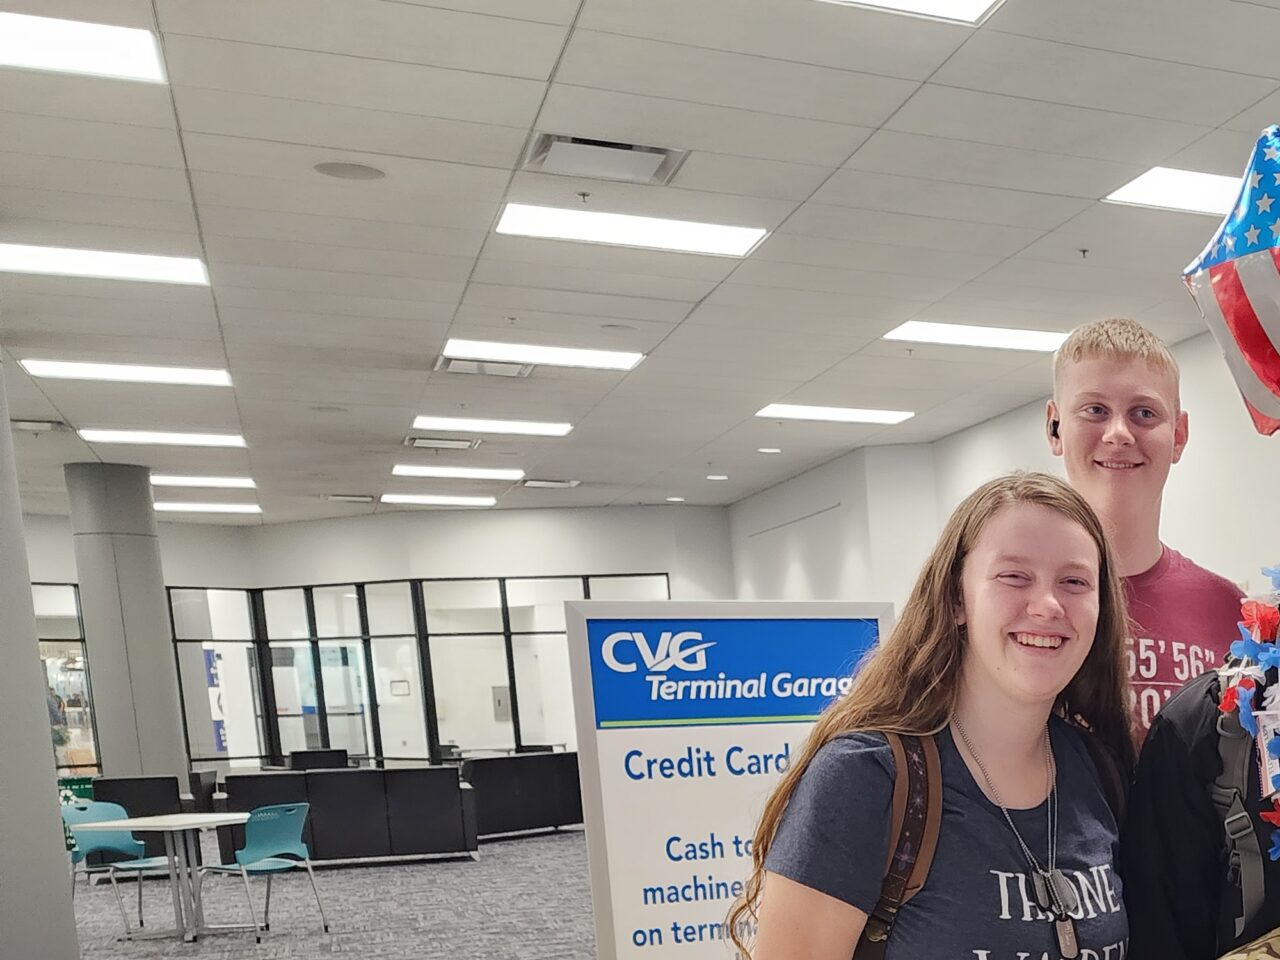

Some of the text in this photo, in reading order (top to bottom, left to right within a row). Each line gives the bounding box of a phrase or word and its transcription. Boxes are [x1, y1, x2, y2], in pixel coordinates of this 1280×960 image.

[601, 631, 718, 673] CVG
[645, 672, 854, 701] Terminal Garag
[624, 742, 791, 780] Credit Card
[665, 832, 724, 862] Cash
[642, 874, 754, 905] machine
[989, 864, 1121, 922] THONE
[632, 928, 663, 946] on
